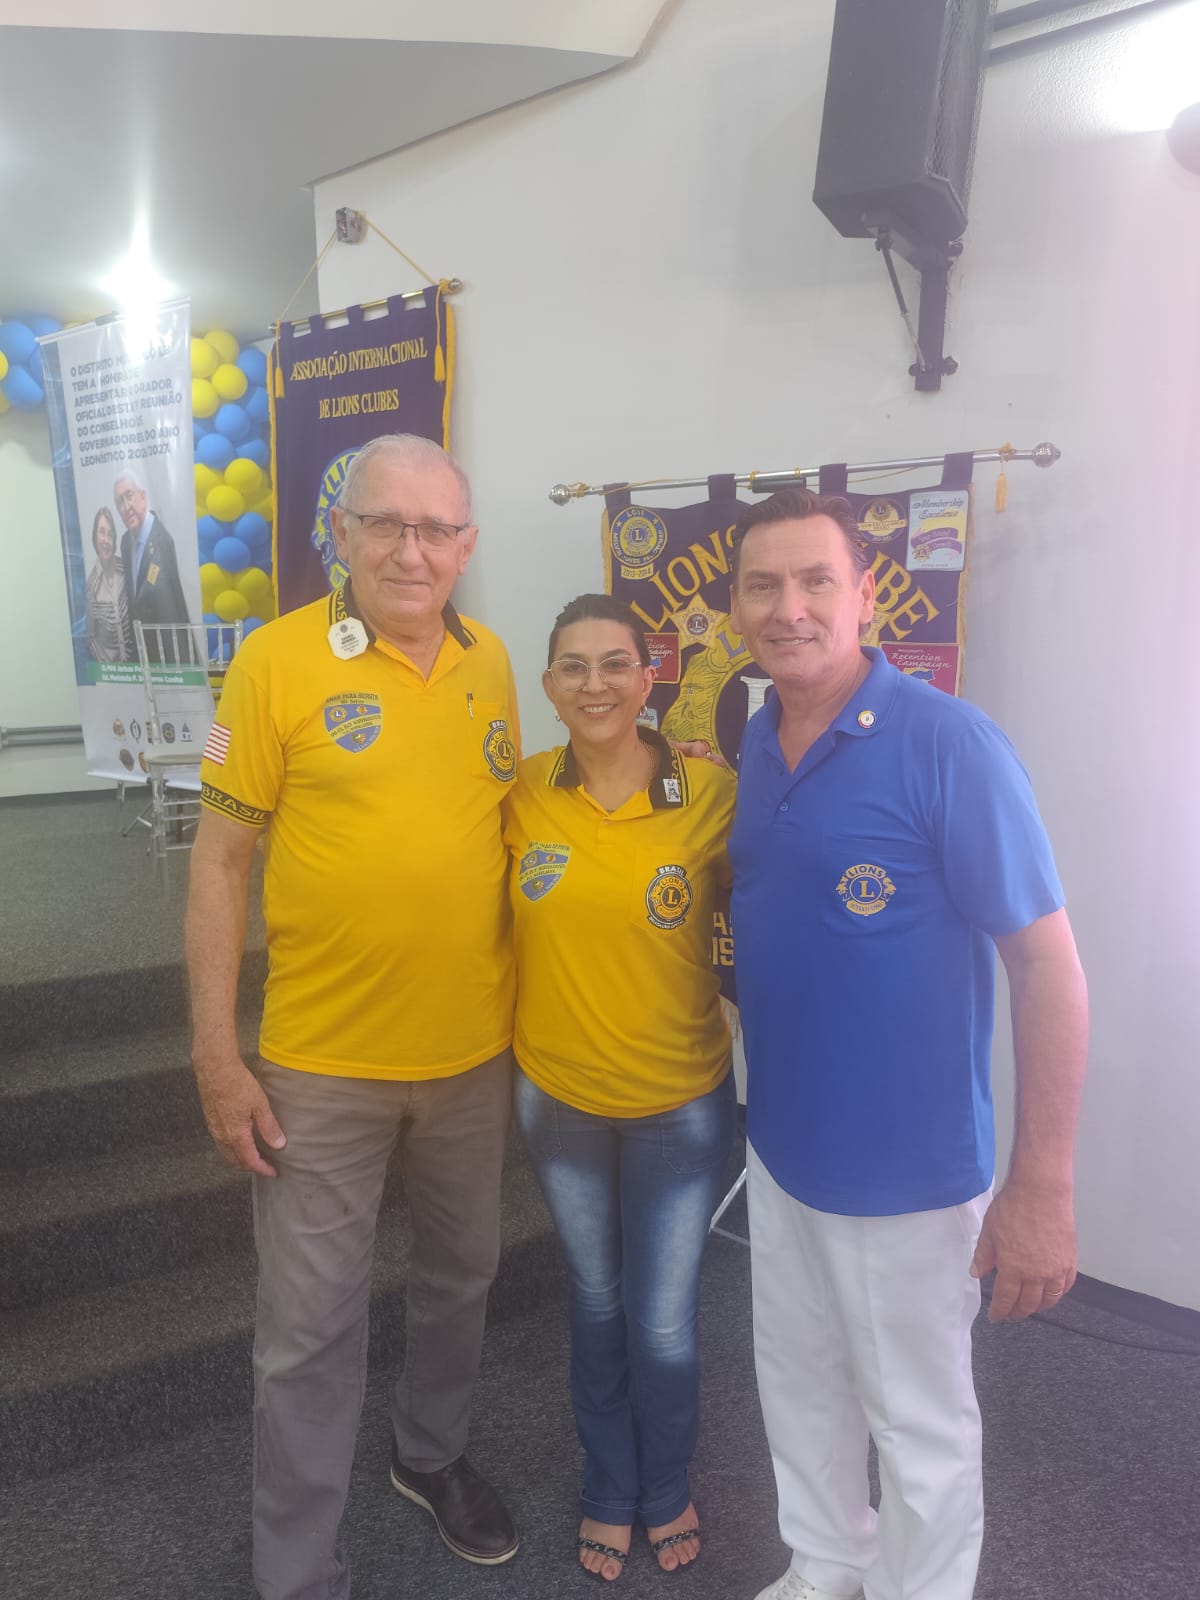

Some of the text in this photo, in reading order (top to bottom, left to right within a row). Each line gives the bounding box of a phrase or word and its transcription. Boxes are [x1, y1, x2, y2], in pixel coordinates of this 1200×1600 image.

[78, 357, 113, 376] DISTRITO
[290, 337, 428, 381] ASSOCIAÇÃO INTERNACIONAL
[72, 380, 88, 392] TEM
[89, 379, 96, 389] A
[75, 406, 106, 422] OFICIAL
[140, 391, 182, 409] REUNIÃO
[319, 388, 399, 420] DE LIONS CLUBES
[77, 427, 88, 438] DO
[90, 416, 136, 436] CONSELHO
[158, 425, 180, 438] ANO
[202, 785, 266, 820] BRASIL
[848, 865, 883, 877] LIONS
[661, 877, 683, 888] LIONS
[859, 880, 875, 898] L
[667, 888, 678, 905] L
